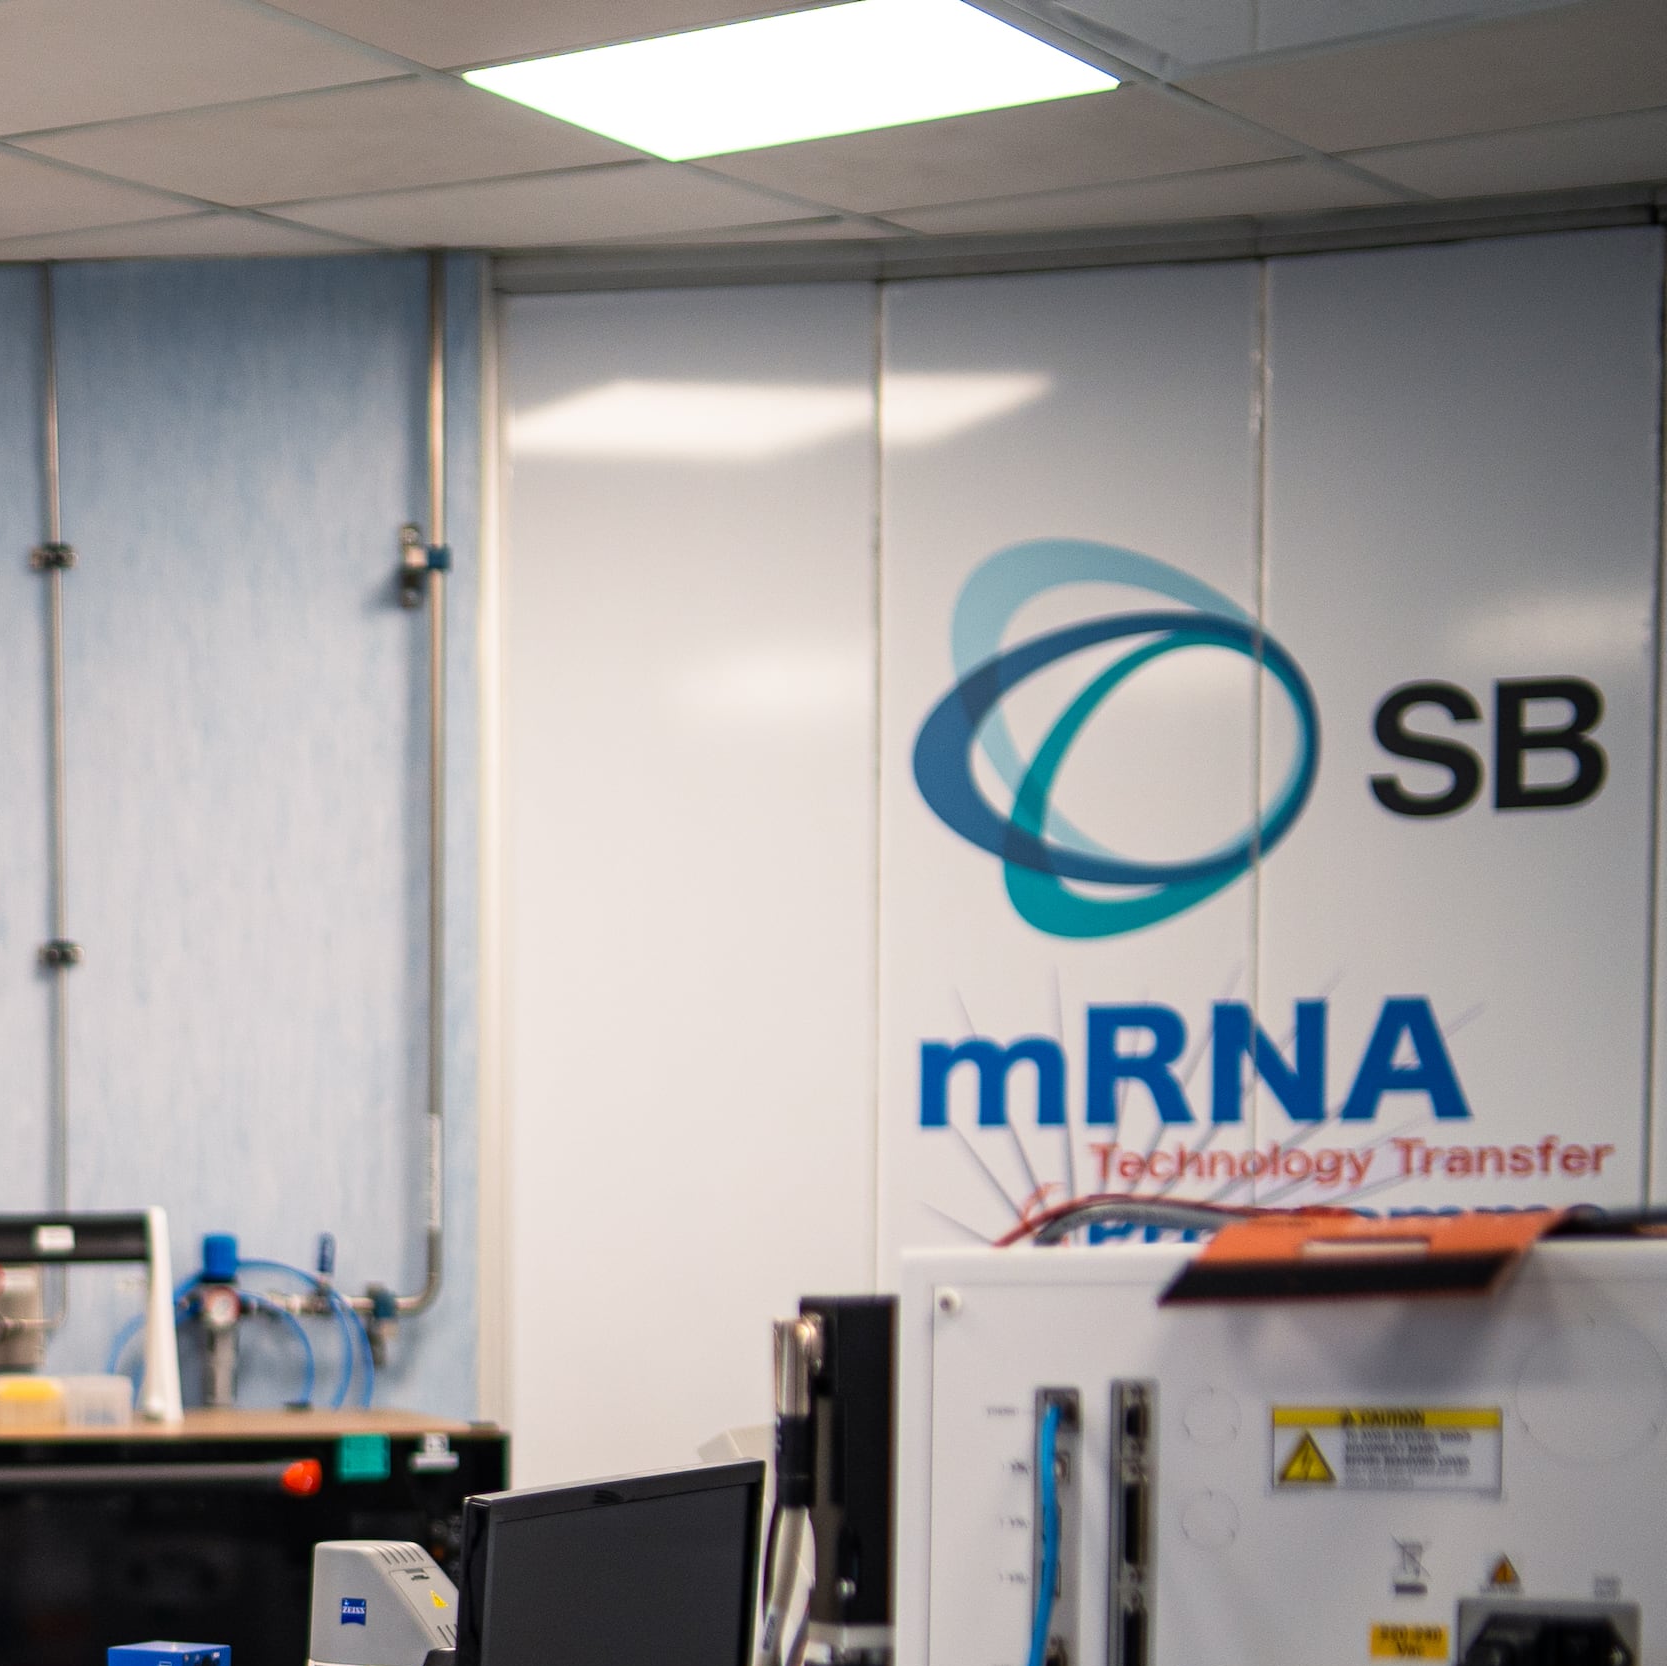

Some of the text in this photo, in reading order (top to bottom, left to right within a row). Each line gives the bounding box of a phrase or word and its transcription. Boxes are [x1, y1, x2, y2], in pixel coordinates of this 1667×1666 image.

[1369, 674, 1609, 821] SB
[919, 995, 1474, 1130] mRNA
[1087, 1135, 1616, 1187] Technology Transfer
[342, 1606, 366, 1614] ZEISS
